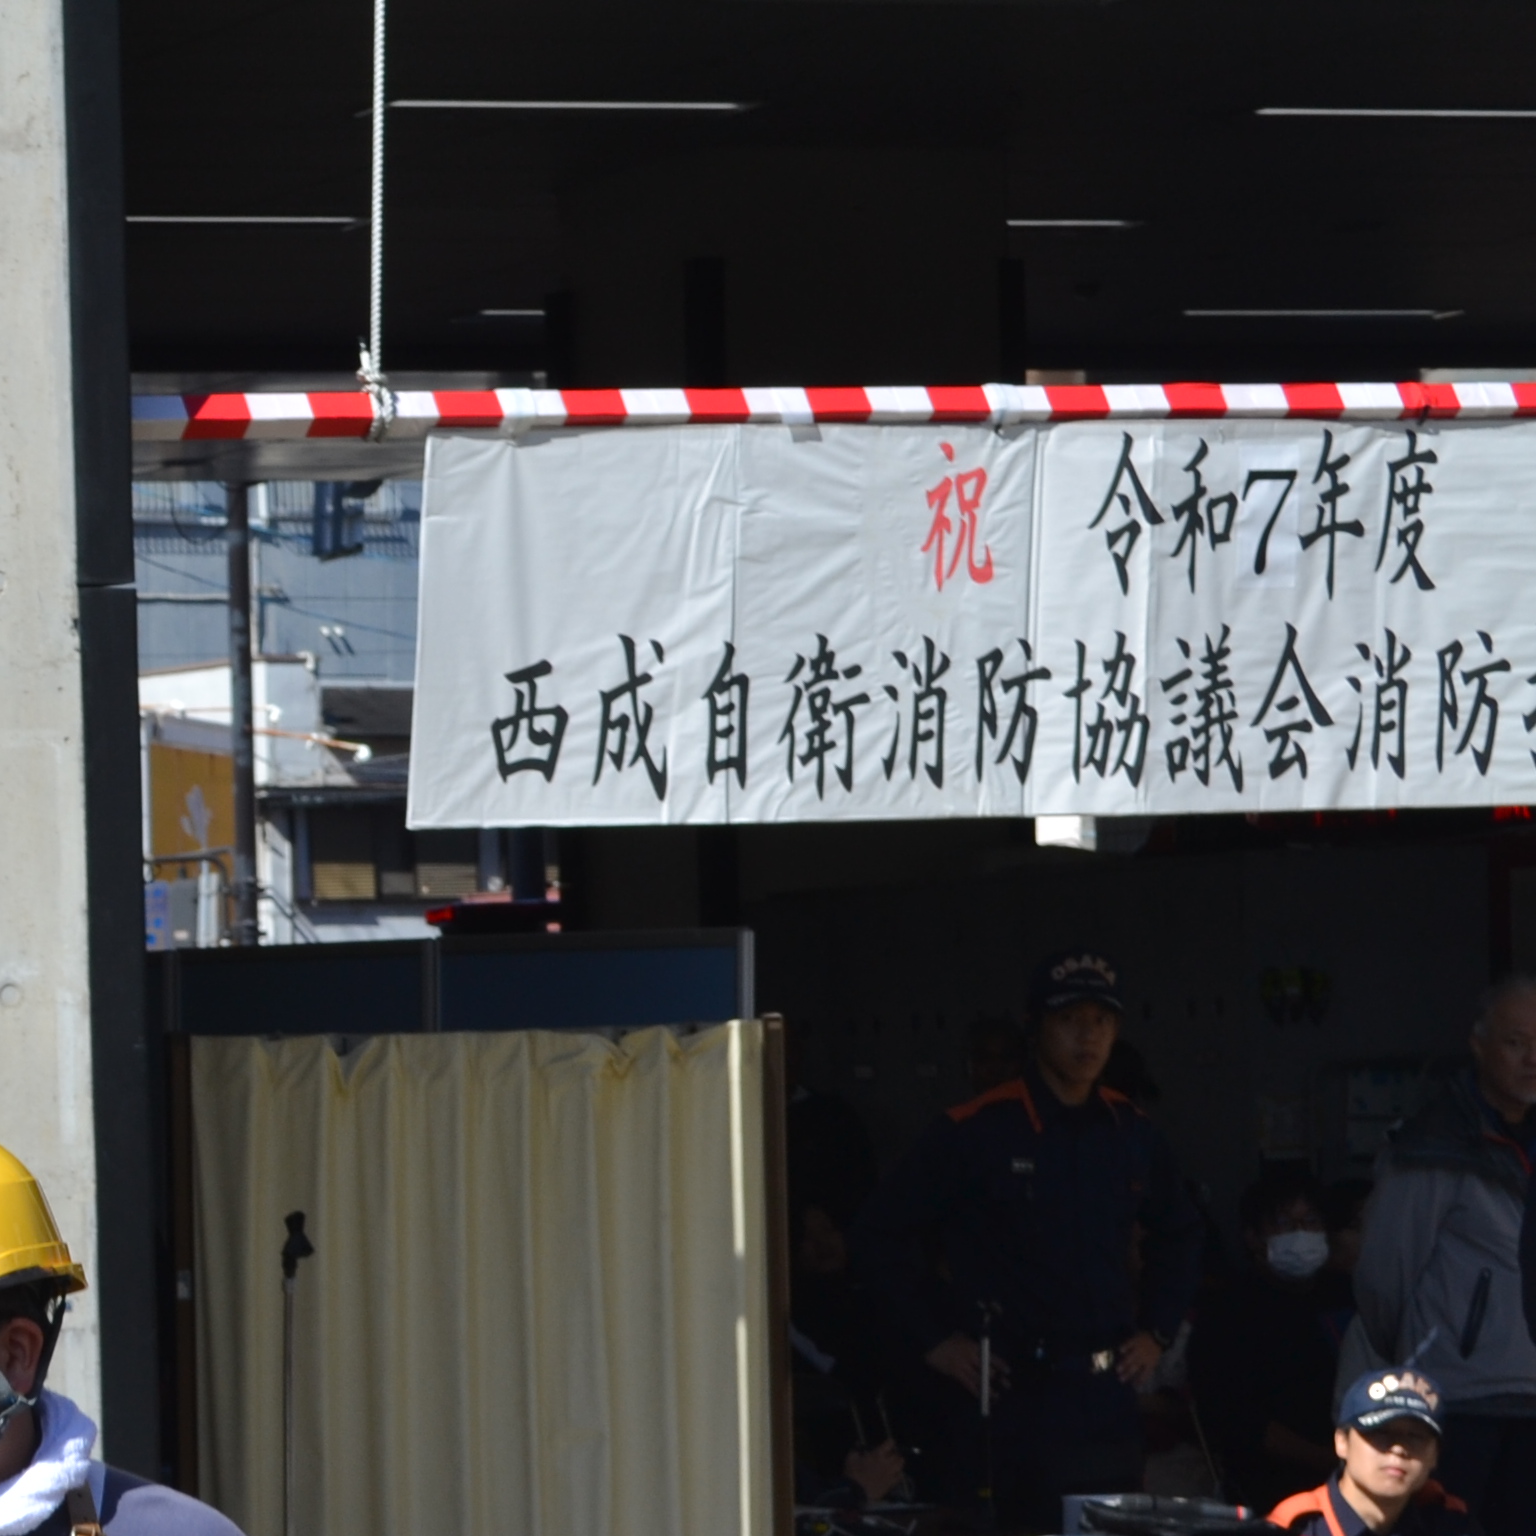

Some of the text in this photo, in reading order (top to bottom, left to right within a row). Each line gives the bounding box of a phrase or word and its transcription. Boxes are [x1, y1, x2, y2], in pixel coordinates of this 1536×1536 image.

[920, 429, 1439, 601] 祝 令和7年度
[491, 621, 1536, 800] 西成自衛消防協議会消防
